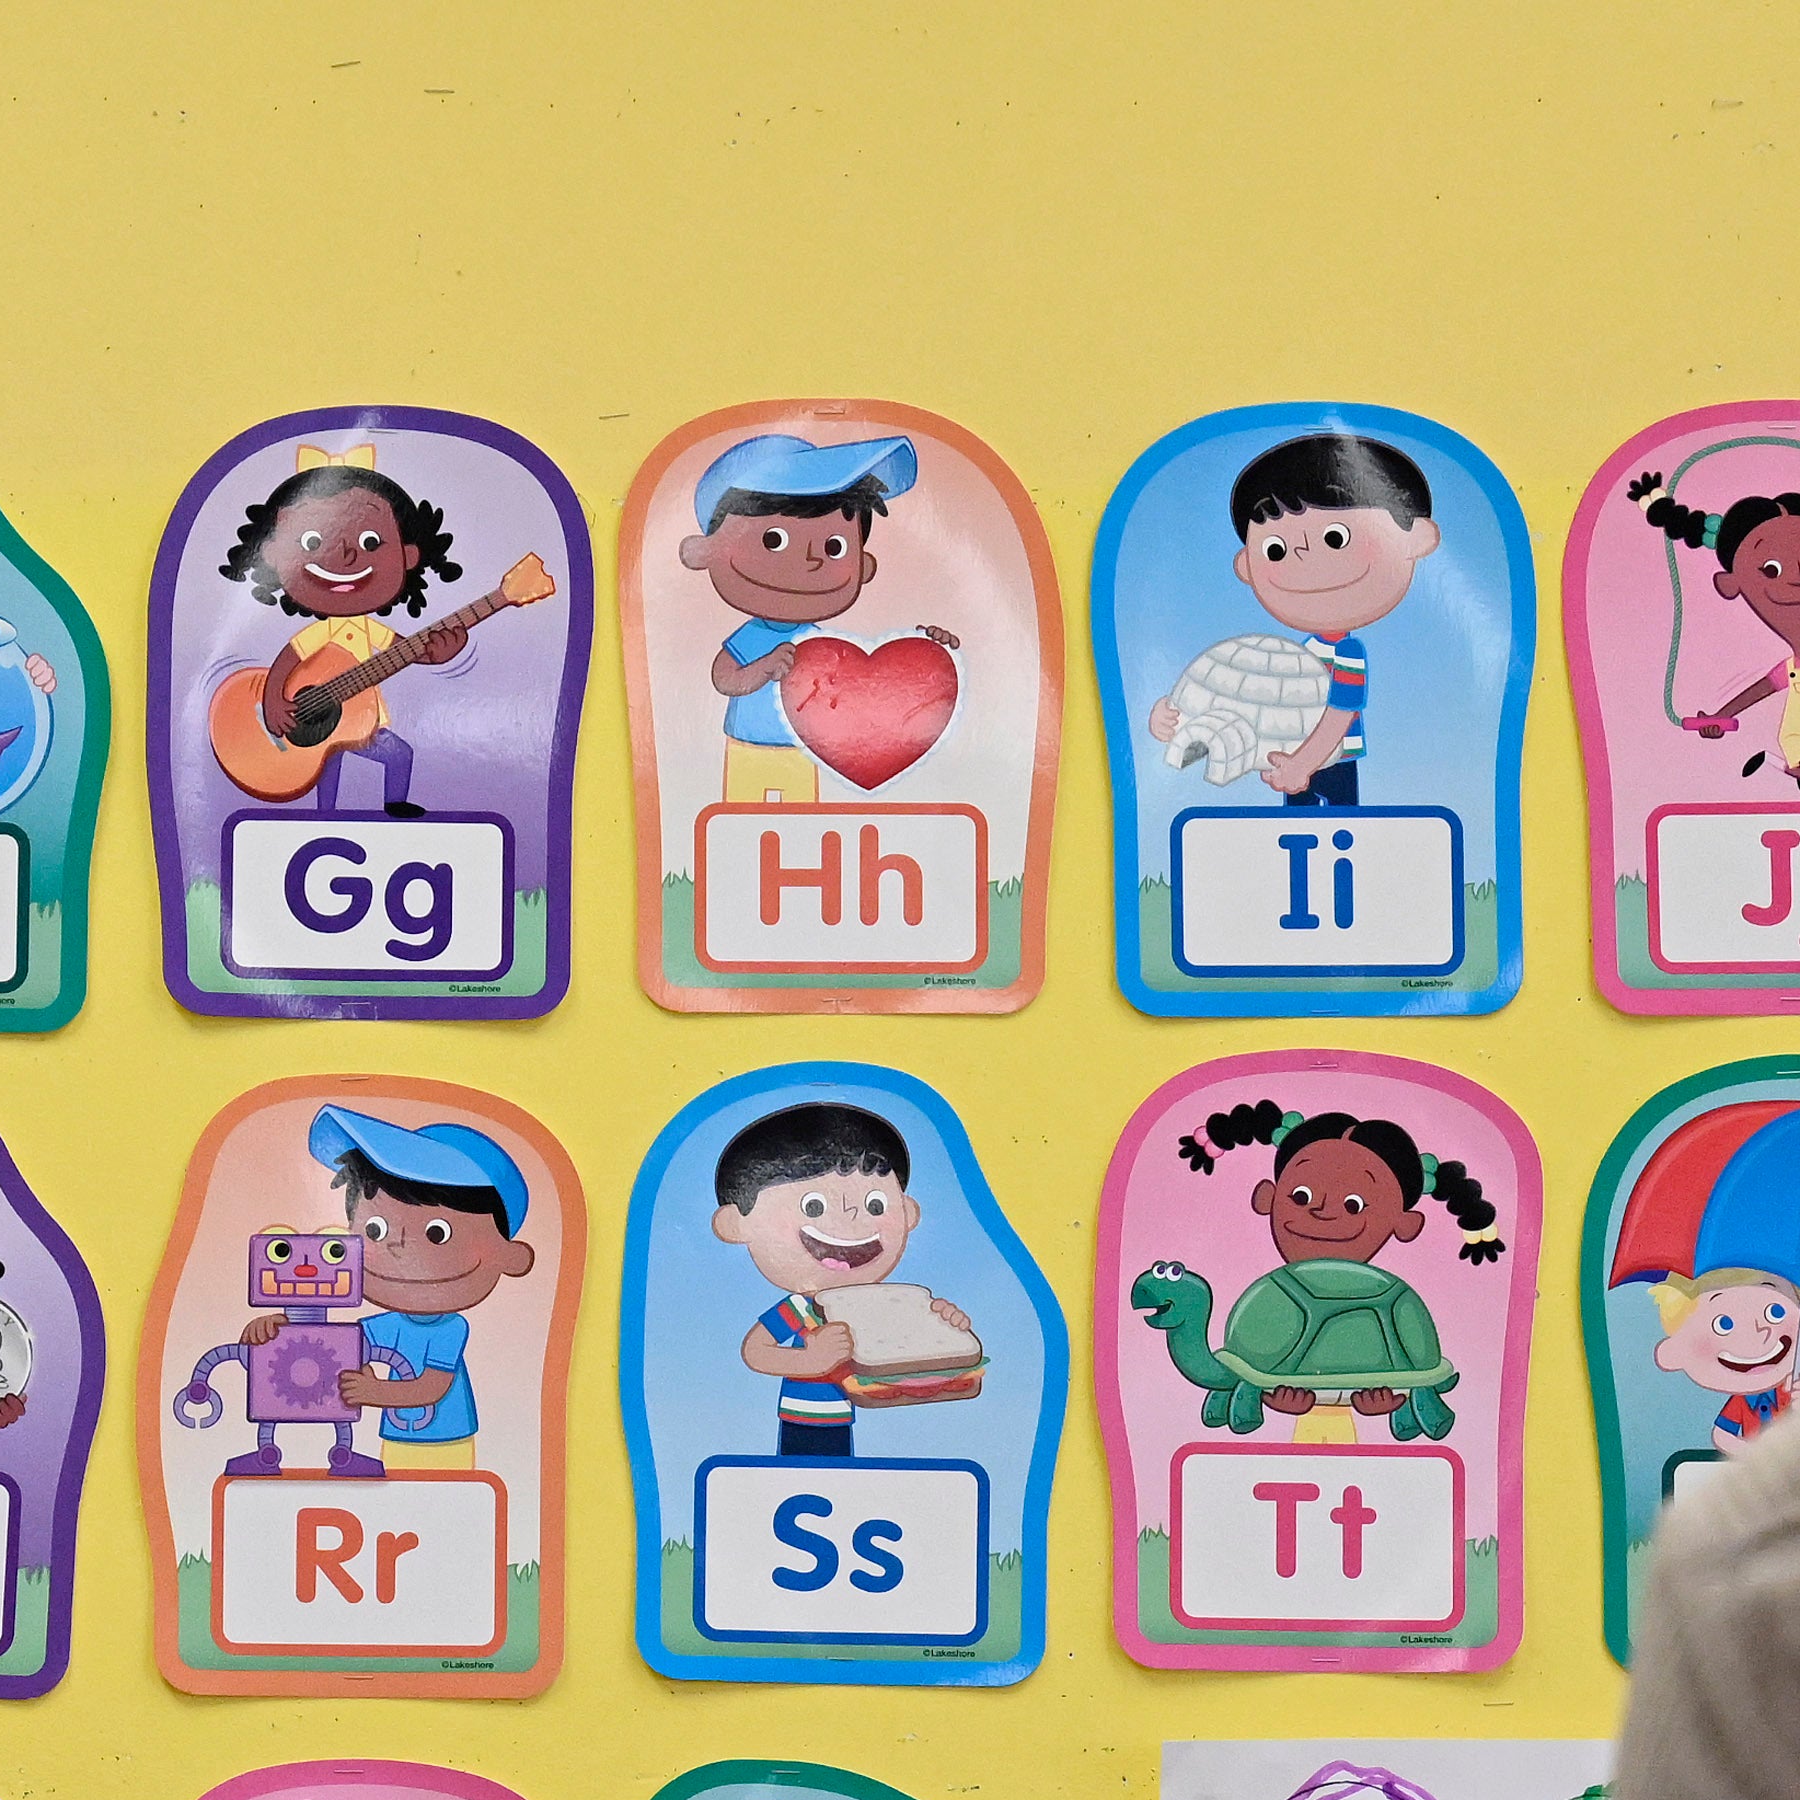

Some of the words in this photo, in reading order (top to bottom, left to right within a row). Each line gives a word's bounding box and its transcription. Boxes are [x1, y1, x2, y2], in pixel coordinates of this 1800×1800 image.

[284, 837, 453, 961] Gg
[760, 825, 922, 926] Hh
[1278, 829, 1354, 929] Ii
[296, 1508, 419, 1604] Rr
[772, 1494, 904, 1593] Ss
[1253, 1483, 1377, 1579] Tt
